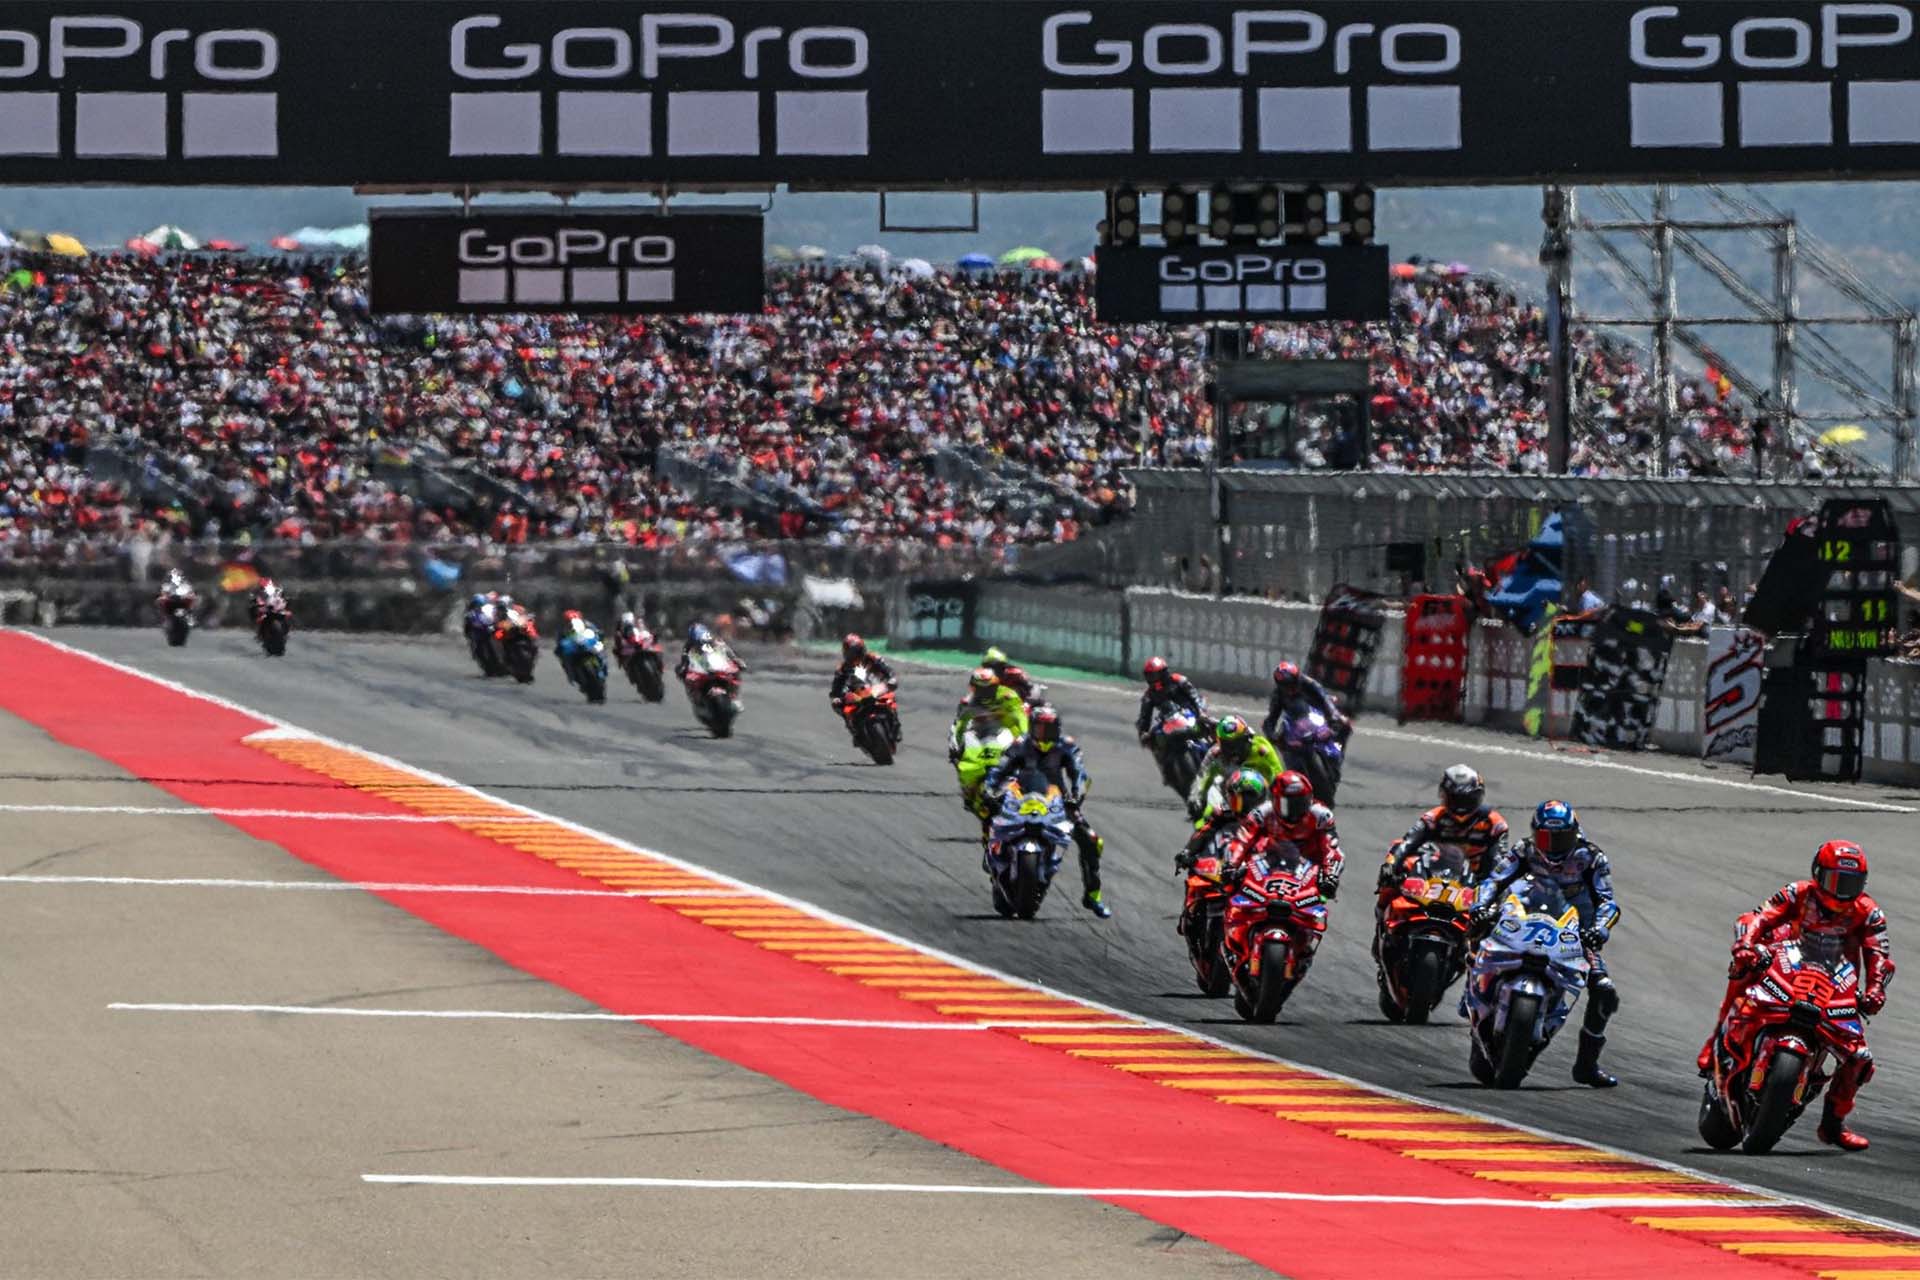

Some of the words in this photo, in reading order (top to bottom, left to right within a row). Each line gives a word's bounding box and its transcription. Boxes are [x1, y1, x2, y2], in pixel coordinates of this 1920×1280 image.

[451, 14, 868, 79] GoPro
[1043, 11, 1460, 75] GoPro
[1631, 4, 1912, 68] GoP
[458, 229, 675, 264] GoPro
[1159, 255, 1326, 282] GoPro
[1523, 921, 1559, 947] 73
[1762, 976, 1790, 1002] Lenovo
[1792, 972, 1835, 1006] 93
[1826, 1007, 1857, 1017] Lenovo
